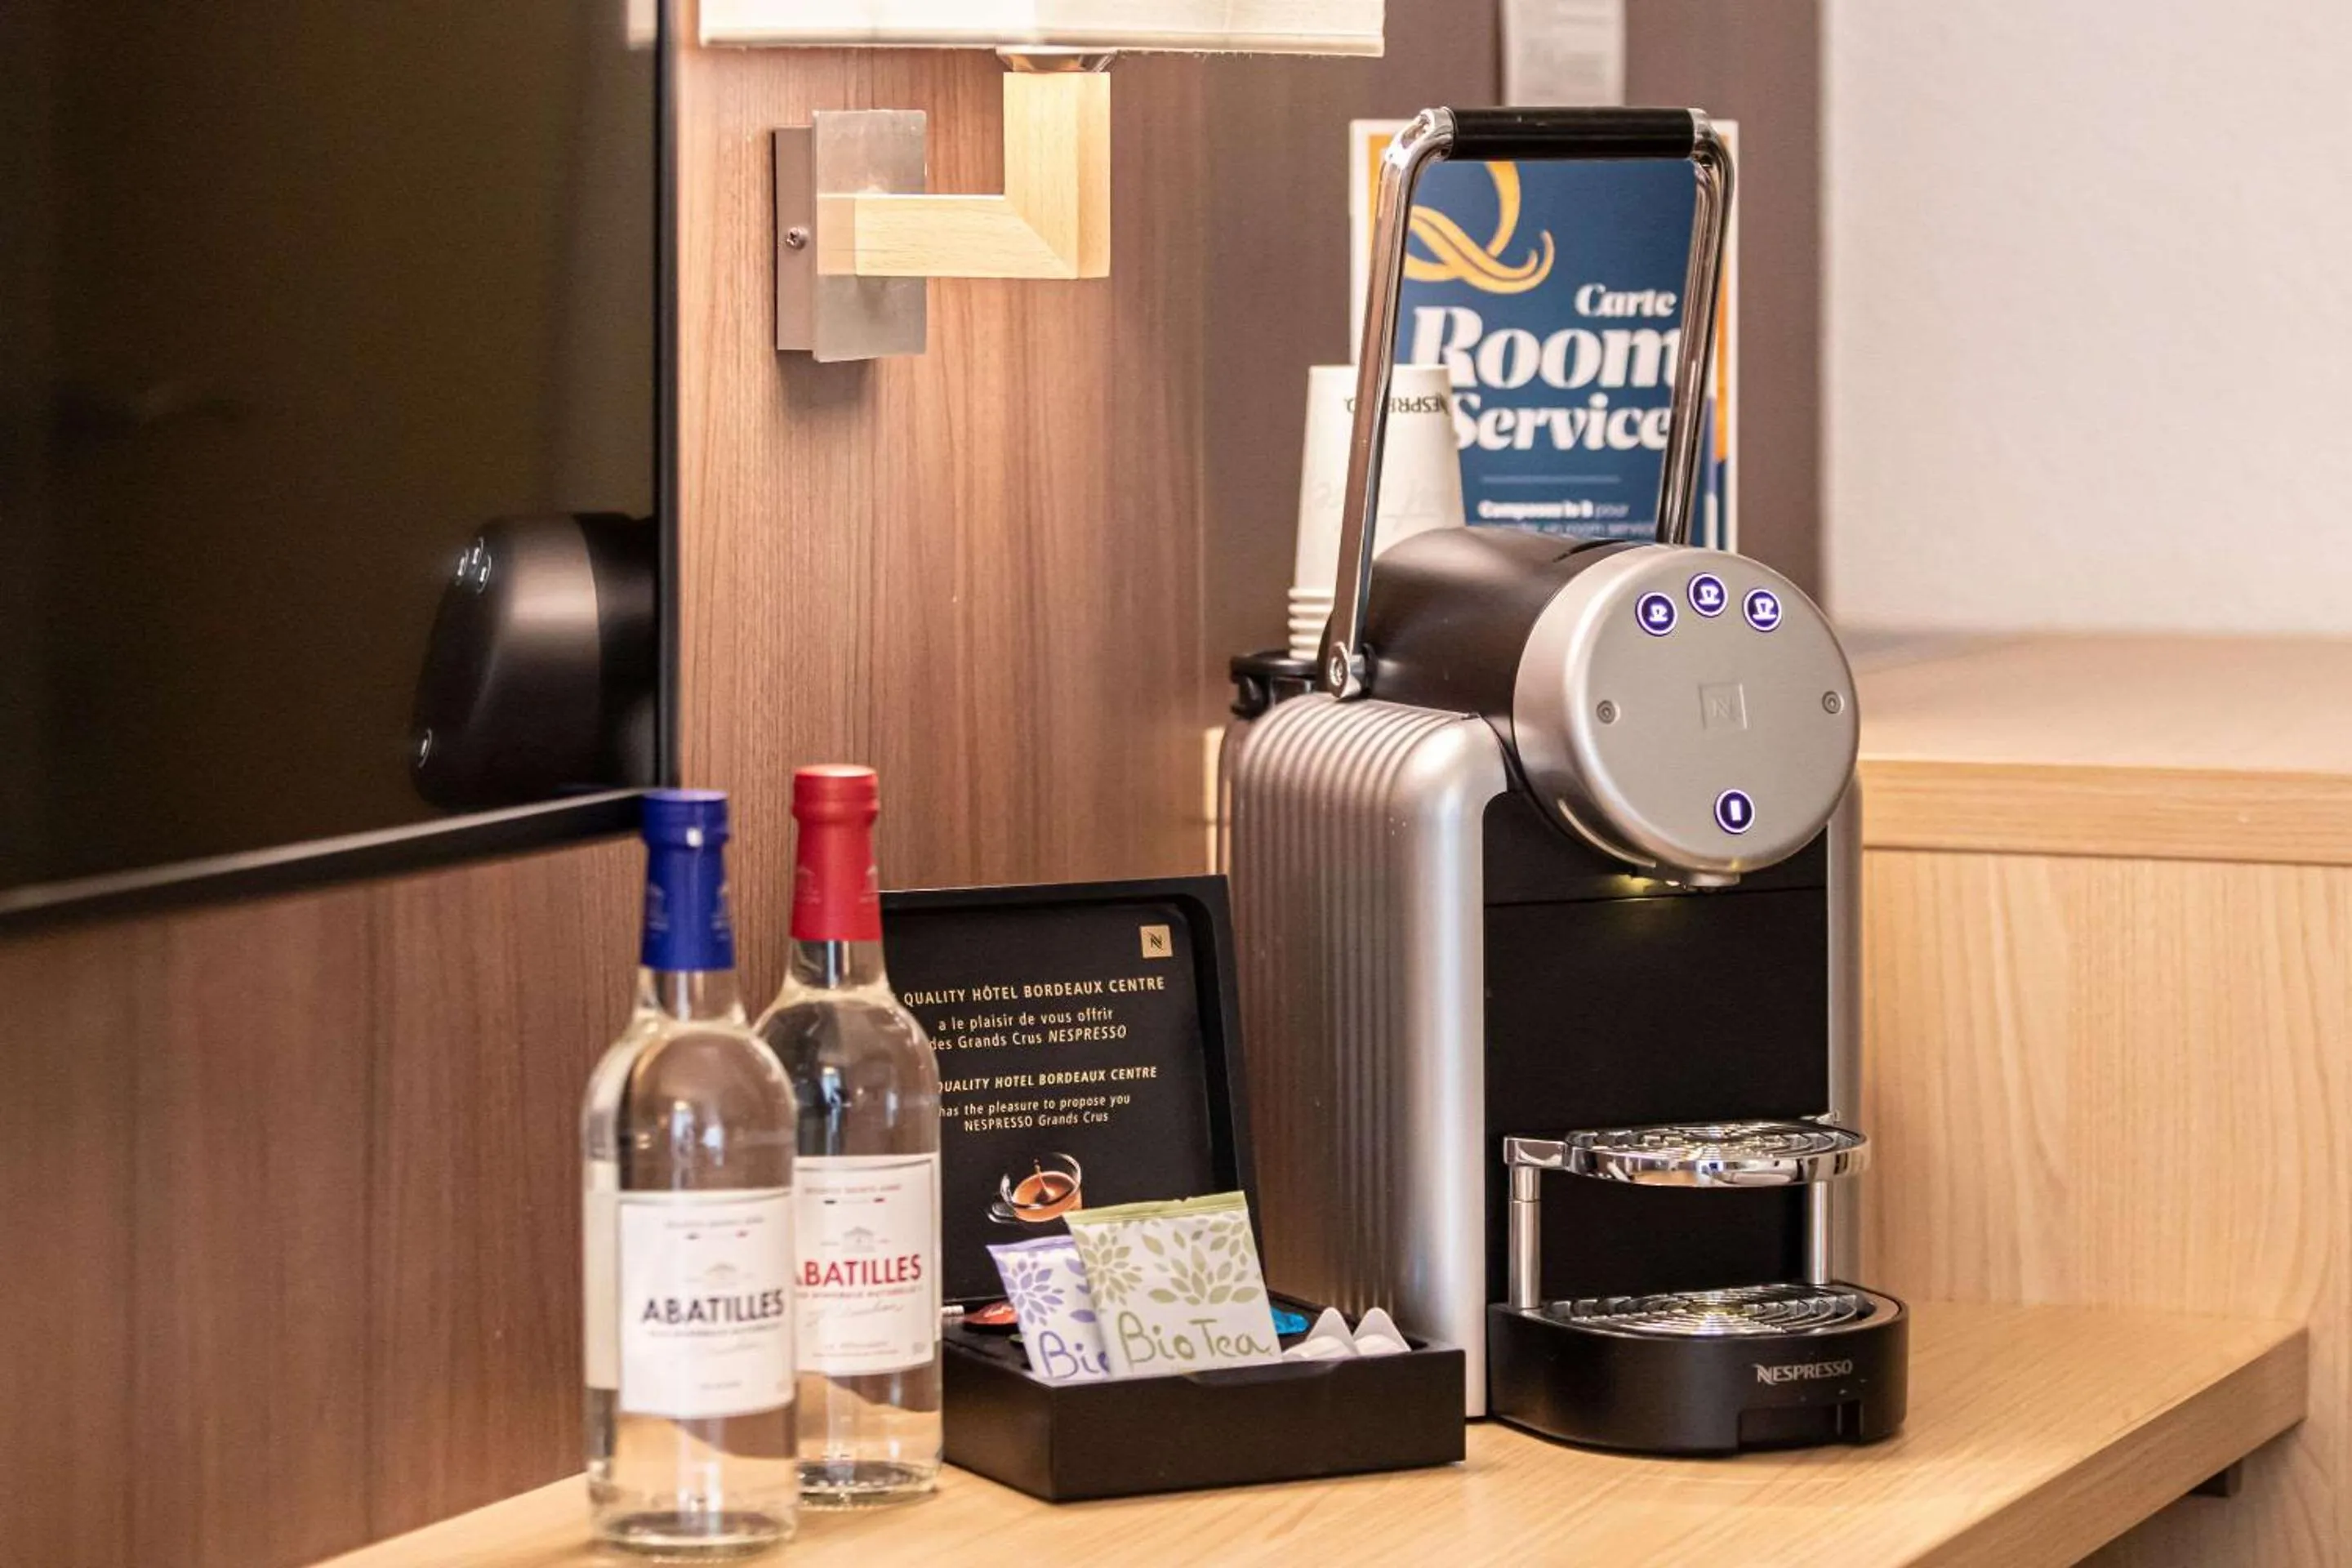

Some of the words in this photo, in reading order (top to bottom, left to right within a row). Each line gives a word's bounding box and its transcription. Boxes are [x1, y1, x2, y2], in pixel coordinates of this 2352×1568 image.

[1575, 283, 1677, 318] Carte
[1413, 305, 1681, 389] Room
[1452, 392, 1673, 450] Service
[903, 989, 965, 1008] QUALITY
[972, 984, 1018, 1002] HÔTEL
[1023, 980, 1103, 999] BORDEAUX
[1108, 977, 1165, 993] CENTRE
[938, 1021, 947, 1031] a
[951, 1016, 964, 1030] le
[969, 1013, 1013, 1031] plaisir
[1018, 1012, 1035, 1027] de
[1040, 1013, 1072, 1024] vous
[1077, 1007, 1113, 1022] offrir
[929, 1037, 952, 1050] des
[957, 1033, 1007, 1049] Grands
[1012, 1031, 1042, 1045] Crus
[1048, 1024, 1127, 1043] NESPRESSO
[995, 1074, 1035, 1089] HOTEL
[1039, 1070, 1107, 1086] BORDEAUX
[1111, 1066, 1157, 1080] CENTRE
[939, 1104, 959, 1117] has
[964, 1102, 984, 1116] the
[988, 1100, 1039, 1116] pleasure
[1044, 1099, 1056, 1110] to
[1060, 1095, 1106, 1111] propose
[1110, 1094, 1131, 1108] you
[964, 1116, 1033, 1132] NESPRESSO
[1038, 1111, 1079, 1127] Grands
[1083, 1111, 1110, 1124] Crus
[641, 1288, 785, 1324] ABATILLES
[1751, 1359, 1853, 1385] NESPRESSO
